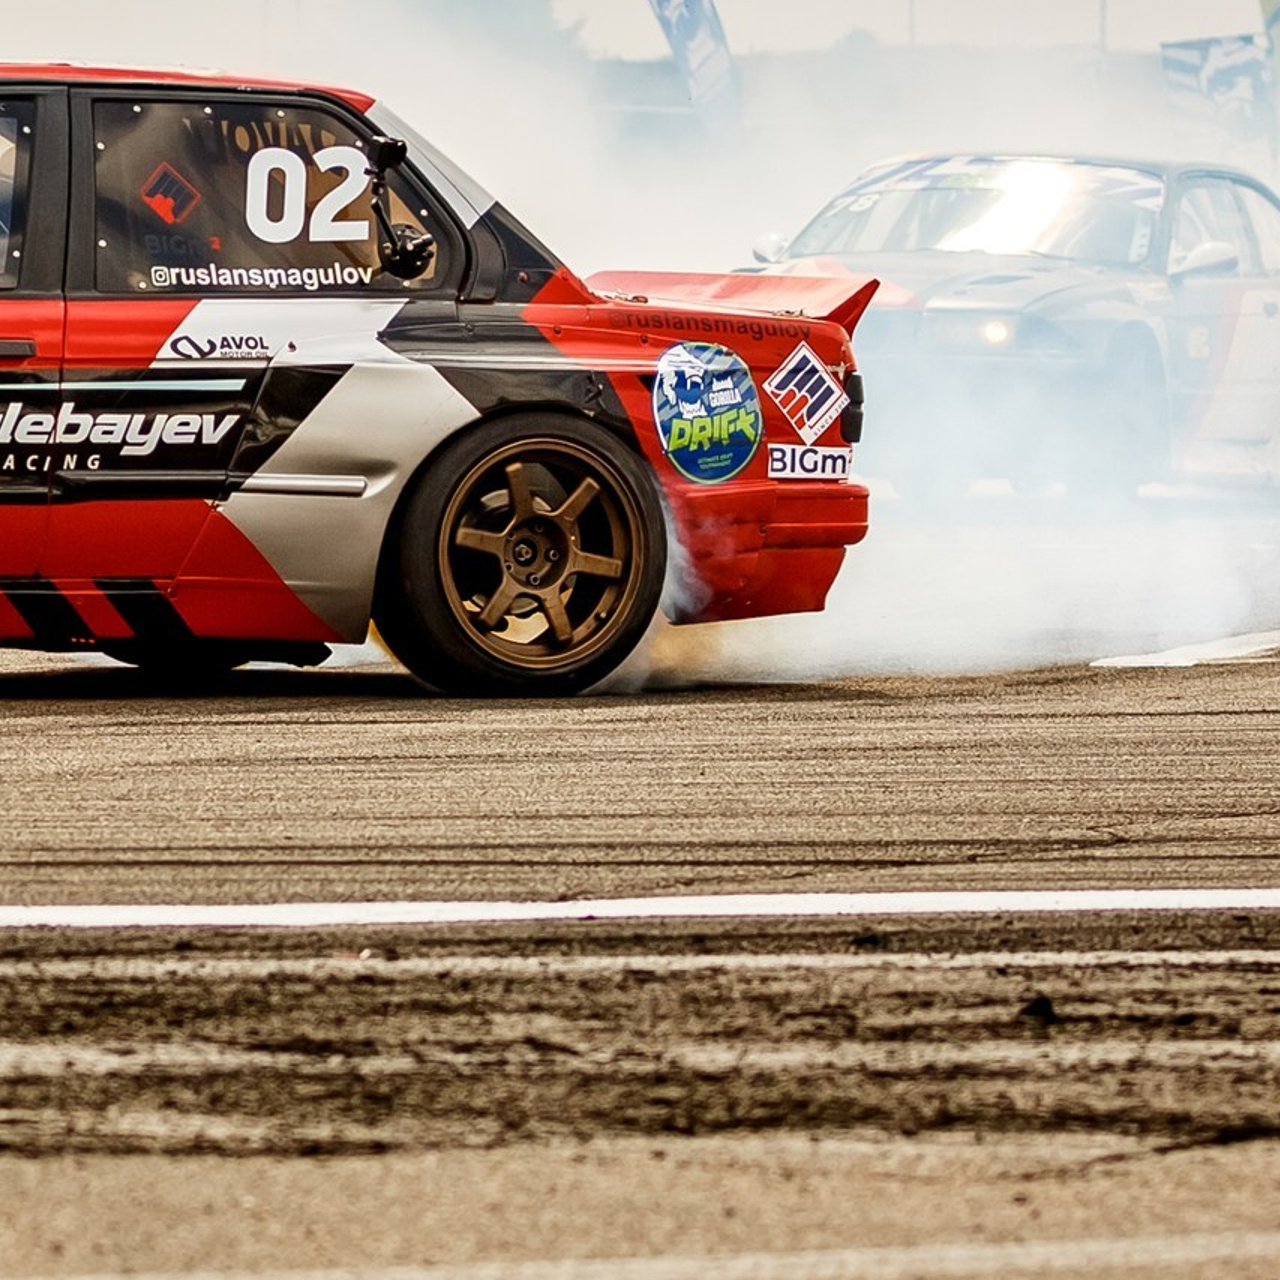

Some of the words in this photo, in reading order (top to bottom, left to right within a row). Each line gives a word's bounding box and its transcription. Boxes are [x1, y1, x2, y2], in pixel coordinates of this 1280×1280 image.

[244, 146, 372, 244] 02
[220, 336, 269, 350] AVOL
[669, 409, 756, 451] DRIFT
